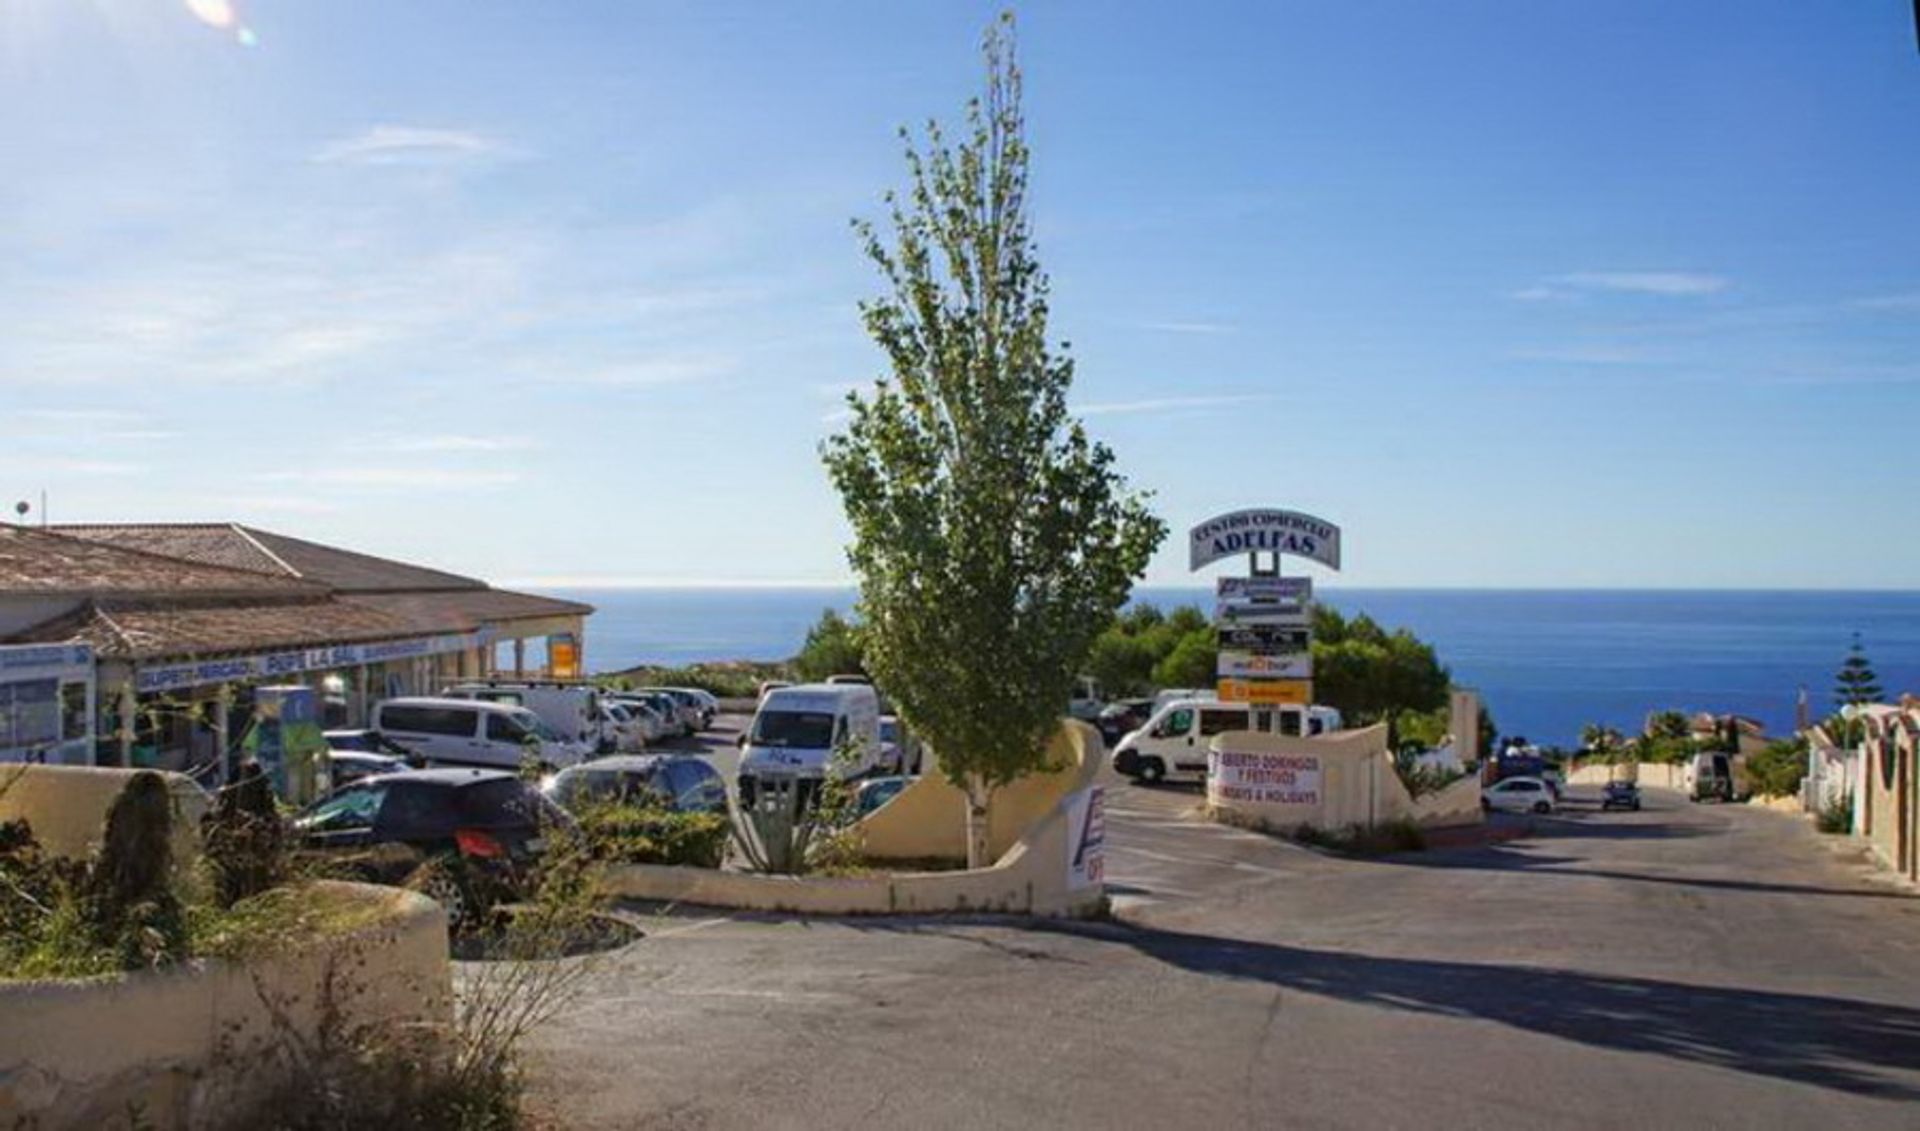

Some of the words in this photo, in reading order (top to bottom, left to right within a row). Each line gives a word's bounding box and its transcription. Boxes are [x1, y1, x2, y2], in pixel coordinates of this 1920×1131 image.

[1195, 515, 1249, 541] CENTRO
[1252, 513, 1331, 540] COMERCIAL
[1212, 530, 1316, 554] ADELFAS
[308, 650, 331, 667] LA
[1261, 755, 1318, 771] DOMINGOS
[1246, 769, 1296, 786] FESTIVOS
[1265, 790, 1317, 804] HOLIDAYS
